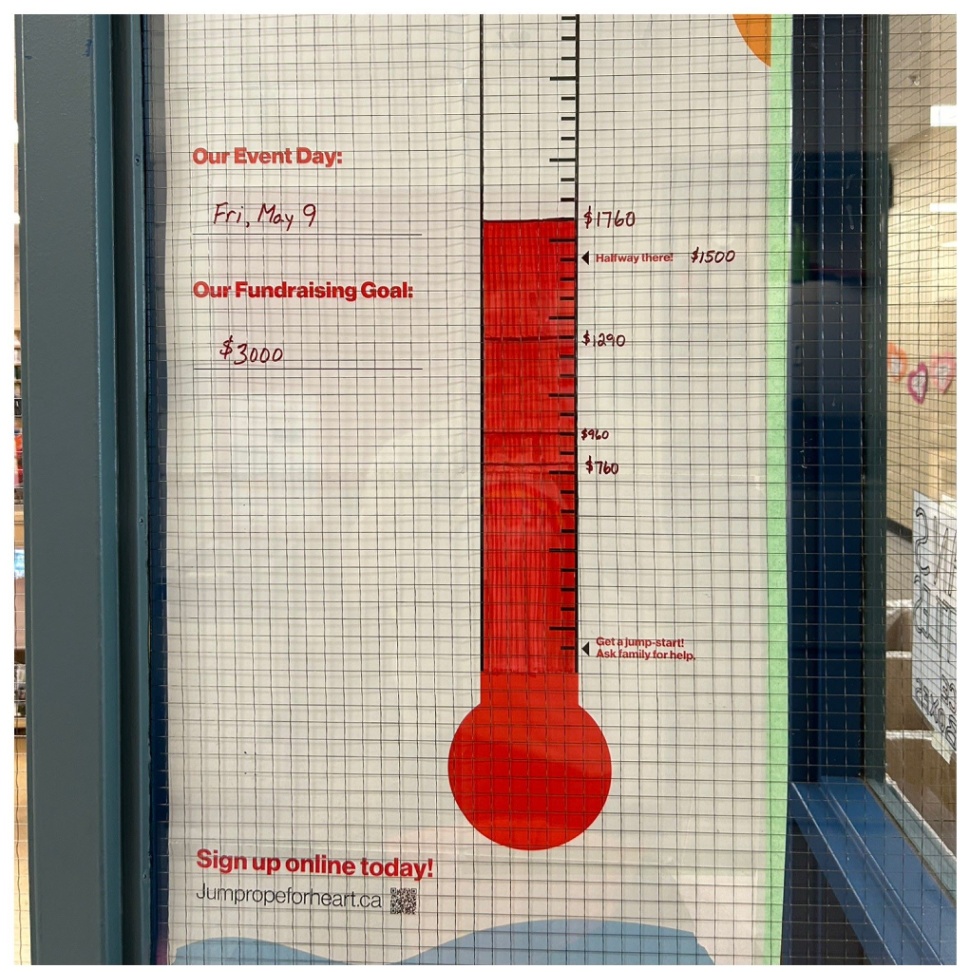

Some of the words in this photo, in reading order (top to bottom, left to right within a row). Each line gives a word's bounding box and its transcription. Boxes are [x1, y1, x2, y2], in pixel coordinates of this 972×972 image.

[192, 147, 229, 165] Our
[234, 146, 292, 164] Event
[296, 147, 343, 168] Day:
[213, 202, 250, 228] Fri,
[257, 203, 294, 231] May
[302, 203, 317, 227] 9
[583, 205, 636, 229] $1760
[595, 253, 639, 264] Halfway
[641, 252, 674, 263] there!
[691, 246, 736, 264] $1500
[192, 280, 231, 298] Our
[234, 280, 357, 302] Fundraising
[360, 281, 414, 299] Goal:
[581, 329, 626, 347] $1290
[219, 335, 283, 365] $3000
[581, 428, 609, 440] $960
[585, 454, 619, 475] $760
[596, 636, 615, 646] Get
[624, 637, 685, 648] jump-start!
[596, 648, 616, 658] Ask
[618, 648, 651, 661] family
[653, 649, 668, 660] for
[670, 650, 696, 662] help.
[196, 848, 248, 874] Sign
[252, 855, 281, 875] up
[285, 853, 356, 876] online
[361, 857, 433, 881] today!
[195, 882, 382, 909] Jumpropeforheart.ca
